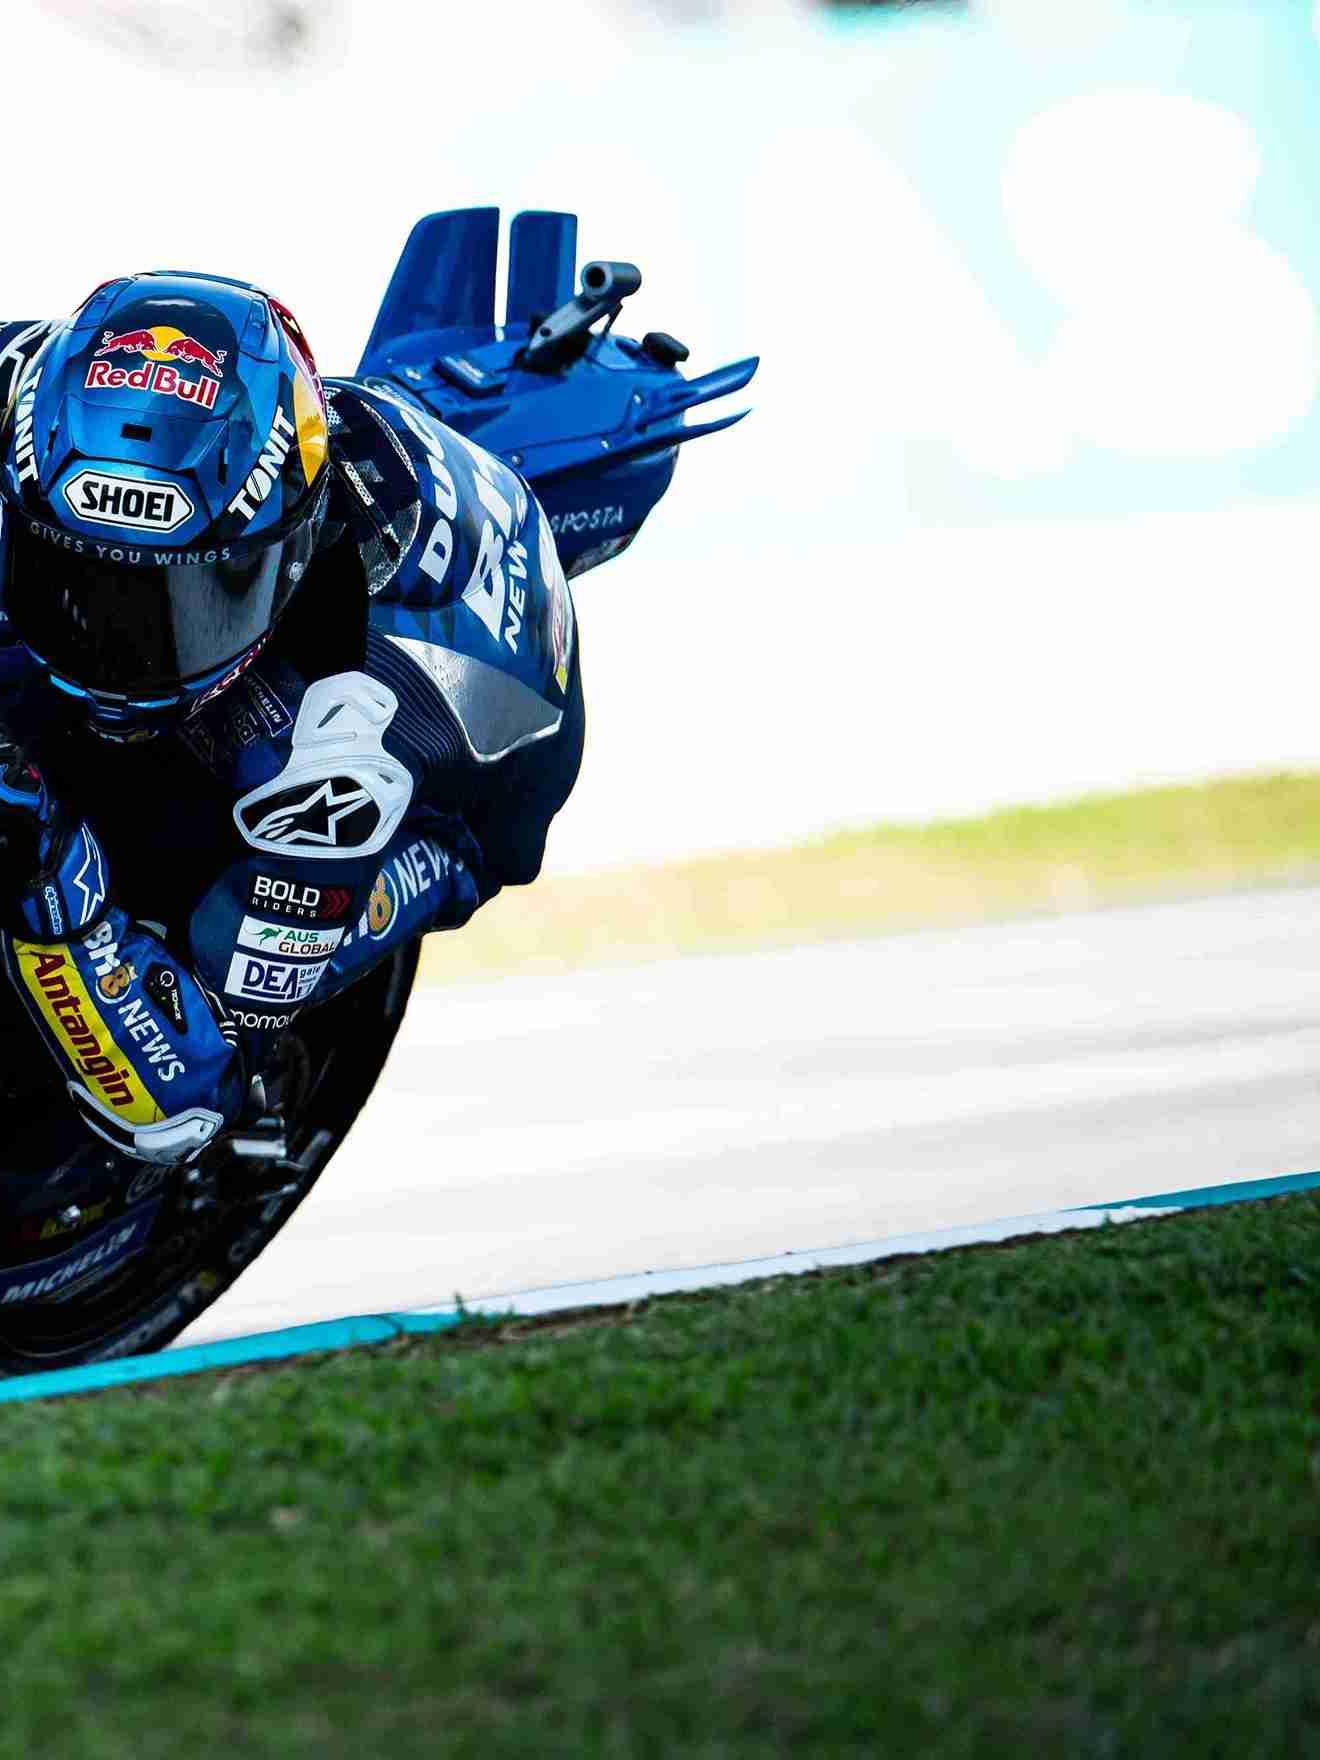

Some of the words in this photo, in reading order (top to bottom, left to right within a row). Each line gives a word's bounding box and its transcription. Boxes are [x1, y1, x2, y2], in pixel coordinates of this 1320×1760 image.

[86, 362, 150, 390] Red
[152, 368, 219, 409] Bull
[229, 406, 295, 520] TONIT
[81, 481, 175, 522] SHOEI
[552, 505, 624, 534] SPOSTA
[30, 522, 83, 552] GIVES
[96, 546, 140, 563] YOU
[155, 548, 230, 566] WINGS
[252, 898, 317, 918] RIDERS
[254, 876, 320, 906] BOLD
[283, 930, 319, 944] AUS
[31, 950, 135, 1106] Antangin
[118, 998, 185, 1082] NEWS
